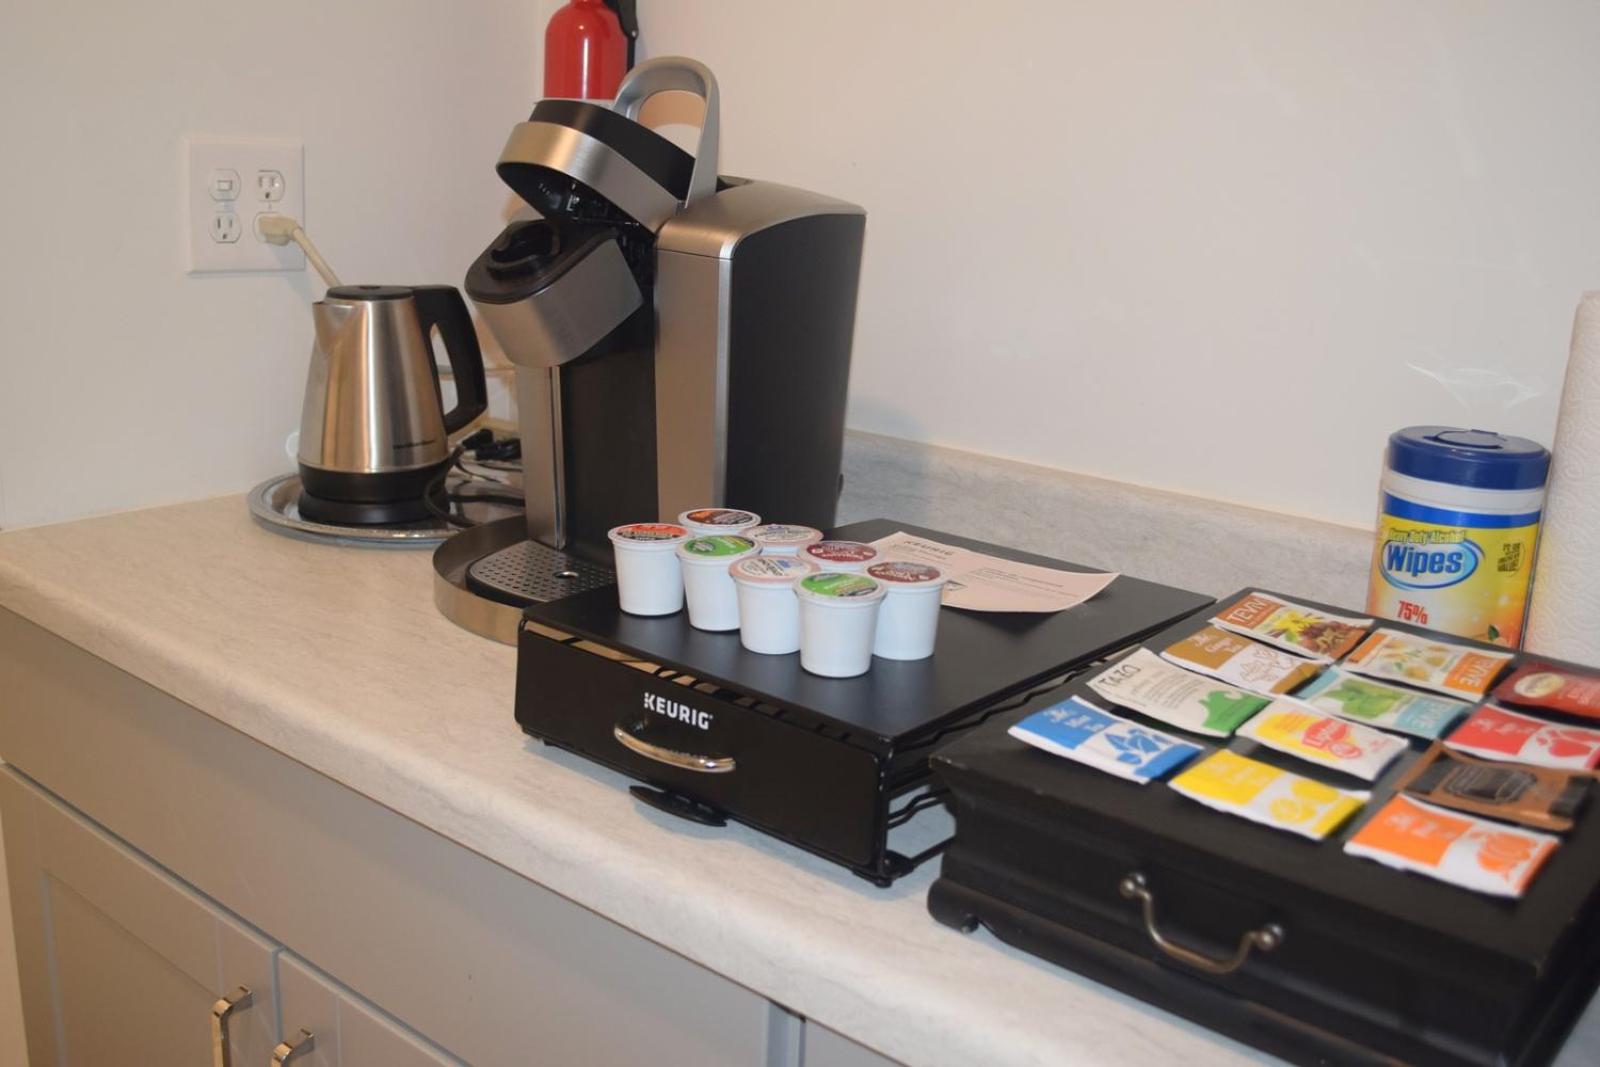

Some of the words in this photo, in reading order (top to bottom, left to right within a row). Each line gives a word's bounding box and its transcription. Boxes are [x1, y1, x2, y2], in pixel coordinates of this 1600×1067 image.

[1387, 544, 1463, 577] Wipes
[1397, 600, 1429, 625] 75%
[1098, 663, 1142, 688] TAZO
[643, 691, 710, 731] KEURIG
